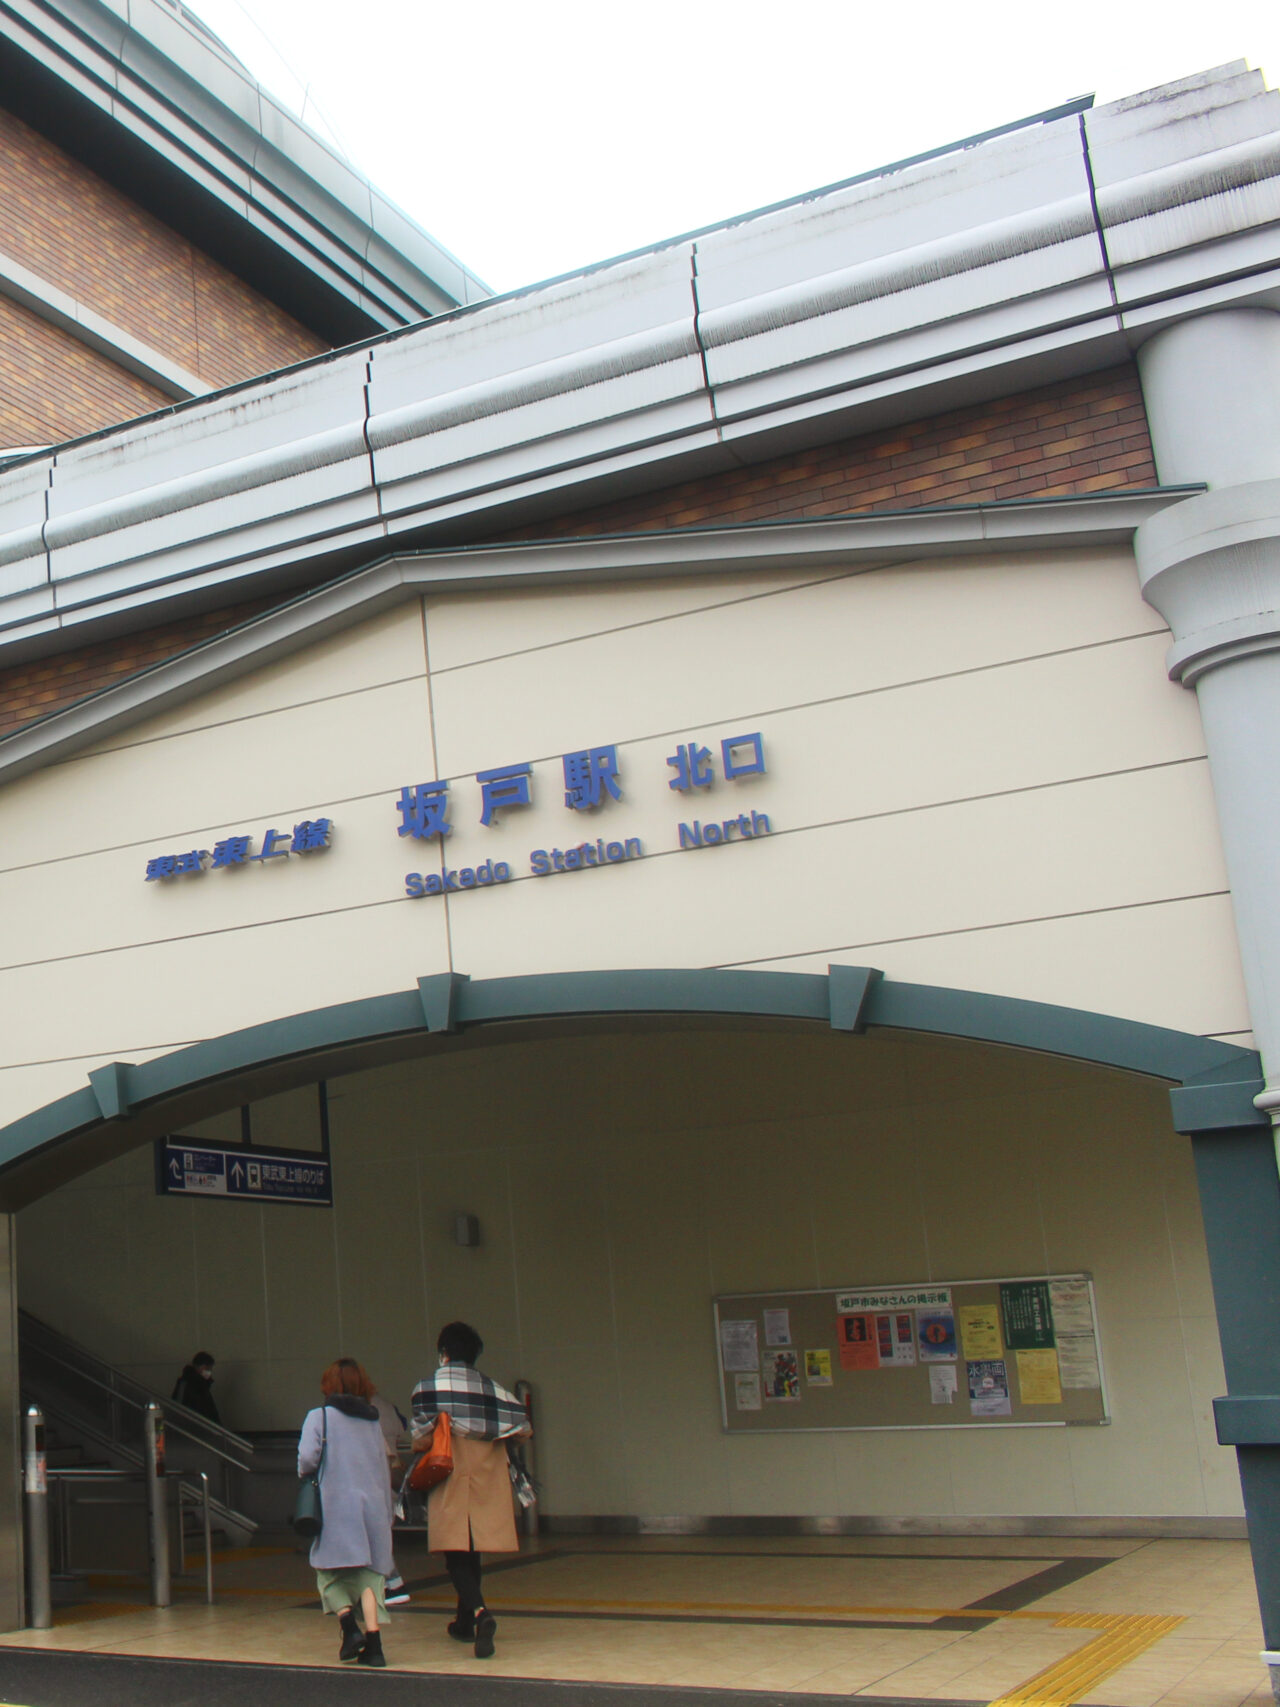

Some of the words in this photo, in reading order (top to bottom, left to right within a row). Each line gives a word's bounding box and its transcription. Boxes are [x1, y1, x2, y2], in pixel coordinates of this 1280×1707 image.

[396, 743, 622, 839] 坂戸駅
[666, 732, 766, 792] 北口
[144, 817, 334, 883] 東武東上線
[405, 858, 511, 897] Sakado
[530, 836, 644, 875] Station
[677, 810, 772, 850] North
[262, 1164, 326, 1185] 東武東上線のりば
